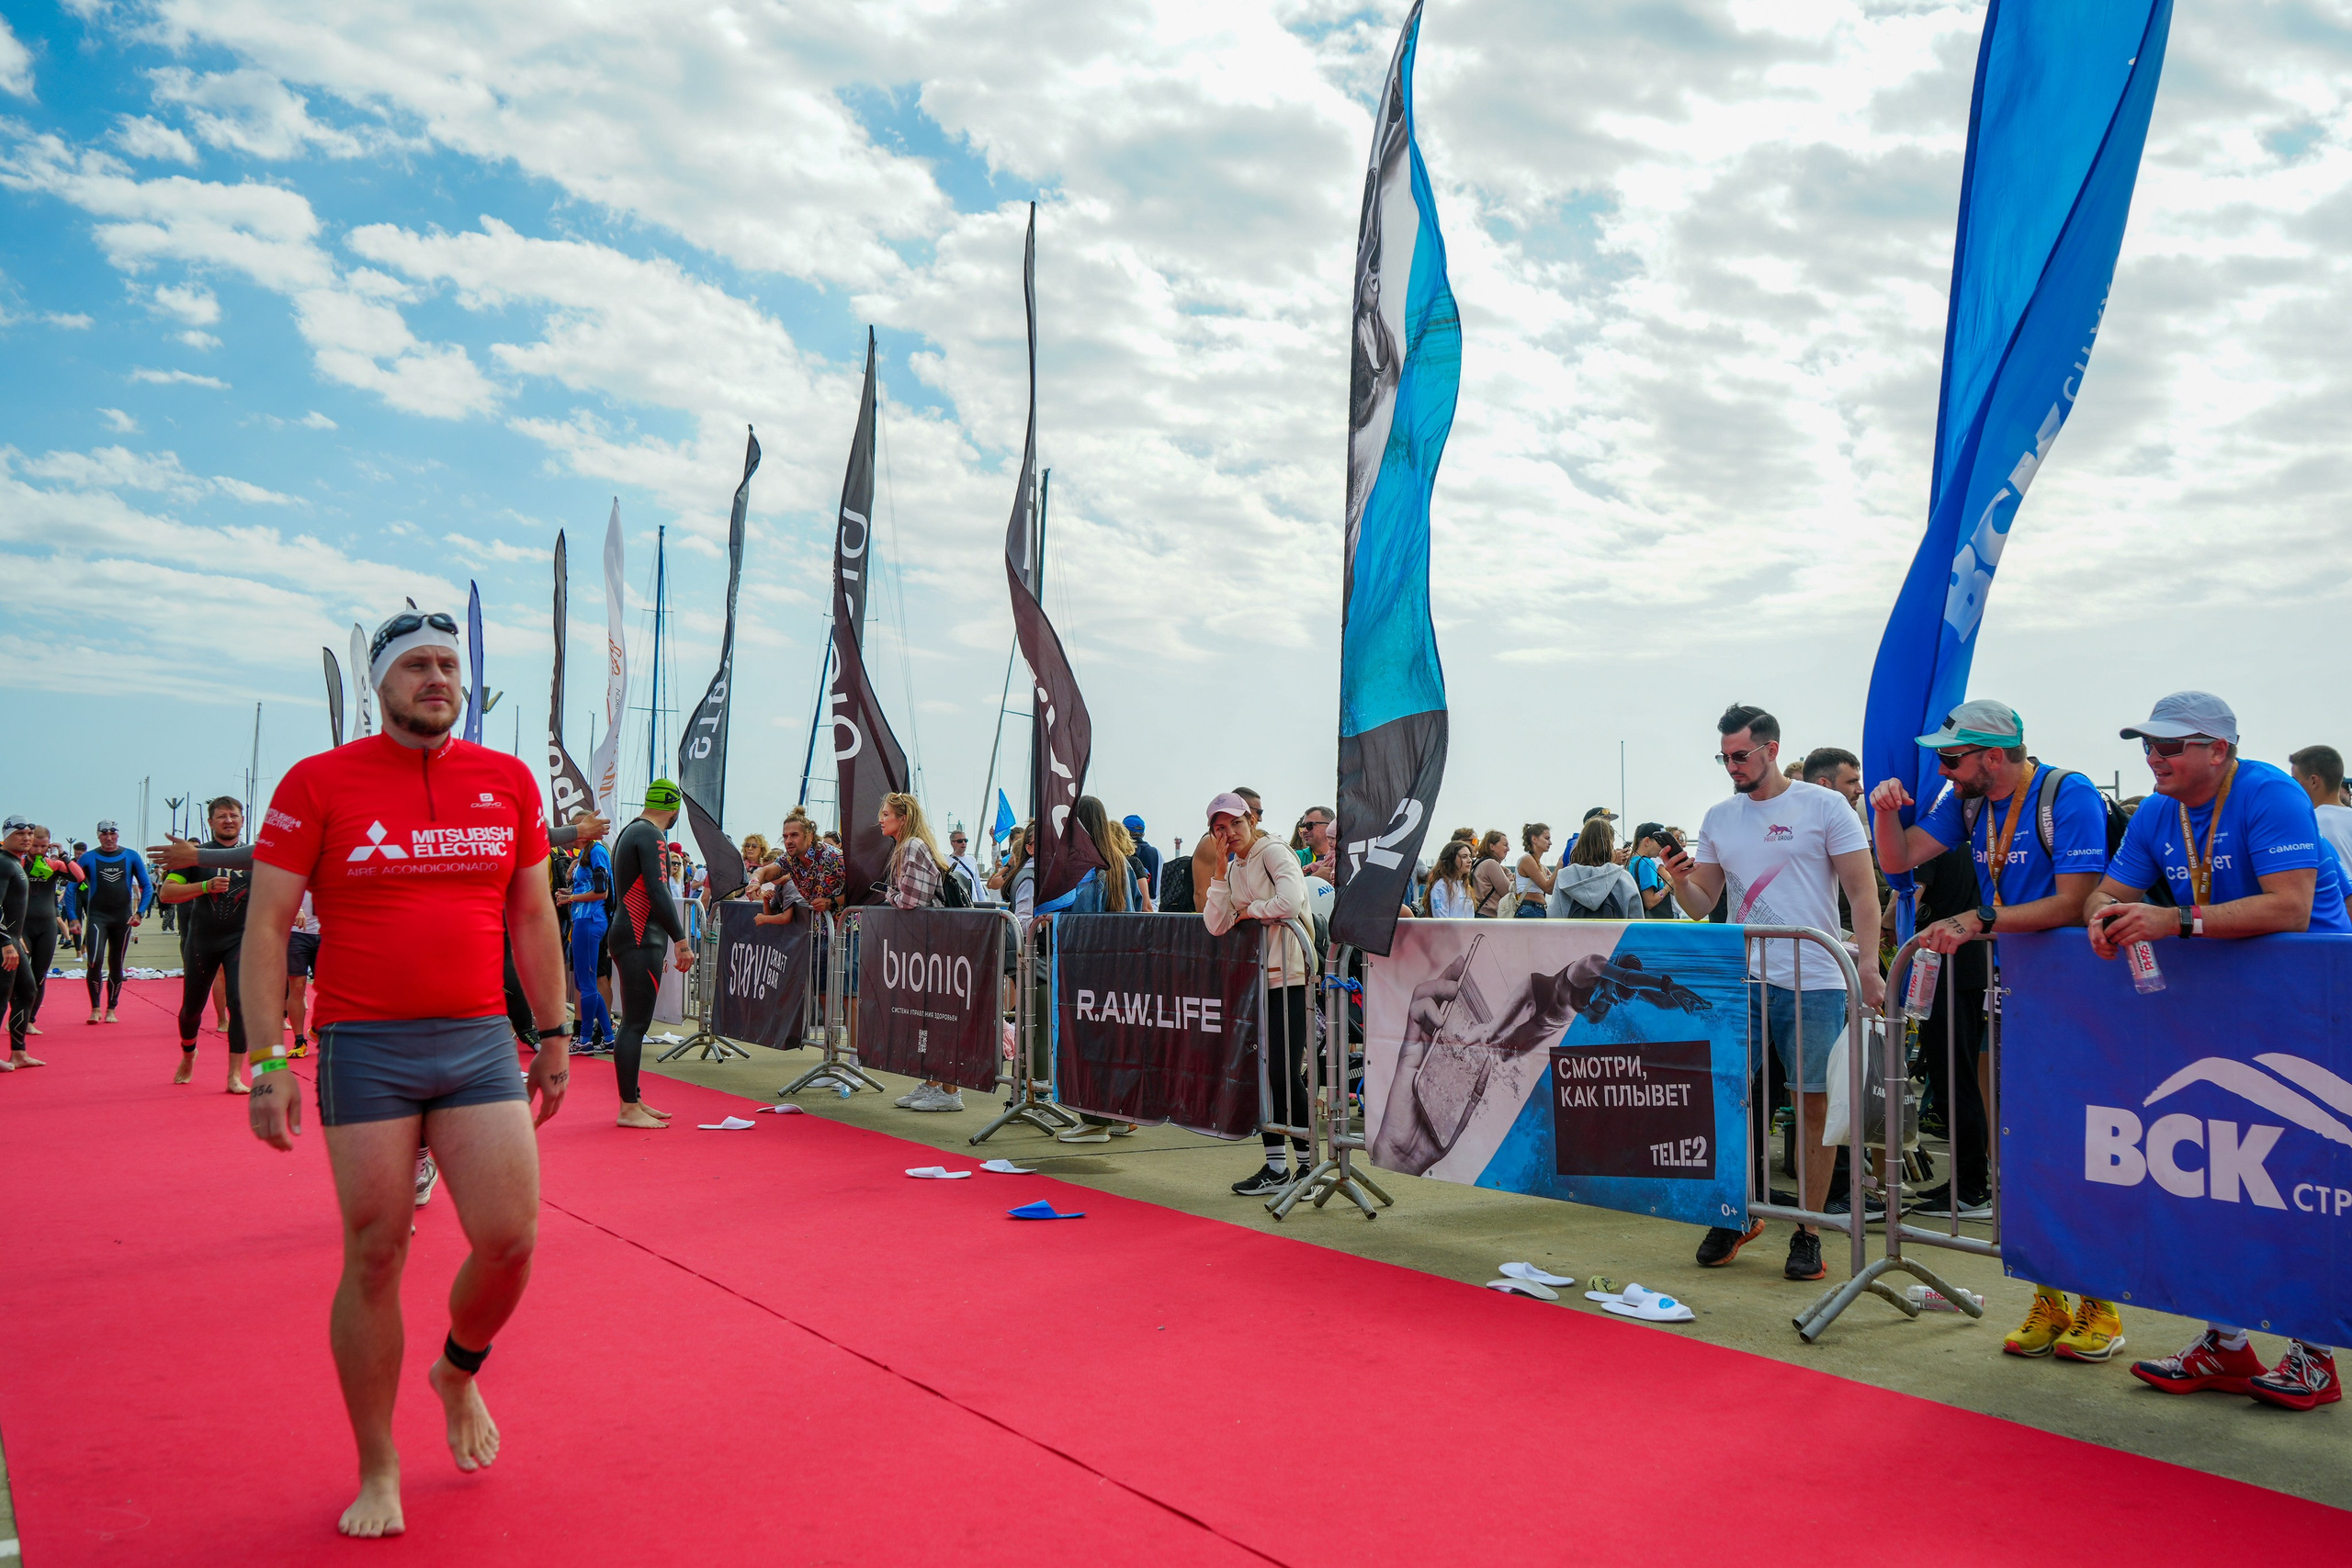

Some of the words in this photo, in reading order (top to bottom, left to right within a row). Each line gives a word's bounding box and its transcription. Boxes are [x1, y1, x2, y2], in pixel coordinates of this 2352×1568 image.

[412, 827, 514, 844] MITSUBISHI
[413, 841, 508, 859] ELECTRIC
[2066, 848, 2104, 857] самолет
[2268, 842, 2315, 854] самолет
[346, 866, 378, 877] AIRE
[381, 862, 499, 875] ACONDICIONADO
[770, 948, 788, 974] CRAFT
[766, 967, 779, 990] BAR
[883, 939, 972, 1010] bioniq
[1558, 1055, 1647, 1081] СМОТРИ,
[1560, 1085, 1600, 1108] КАК
[1603, 1083, 1691, 1108] ПЛЫВЕТ
[1649, 1135, 1709, 1168] TELE2
[2084, 1103, 2290, 1212] ВСК
[2292, 1182, 2352, 1217] СТР
[1721, 1202, 1739, 1217] 0+
